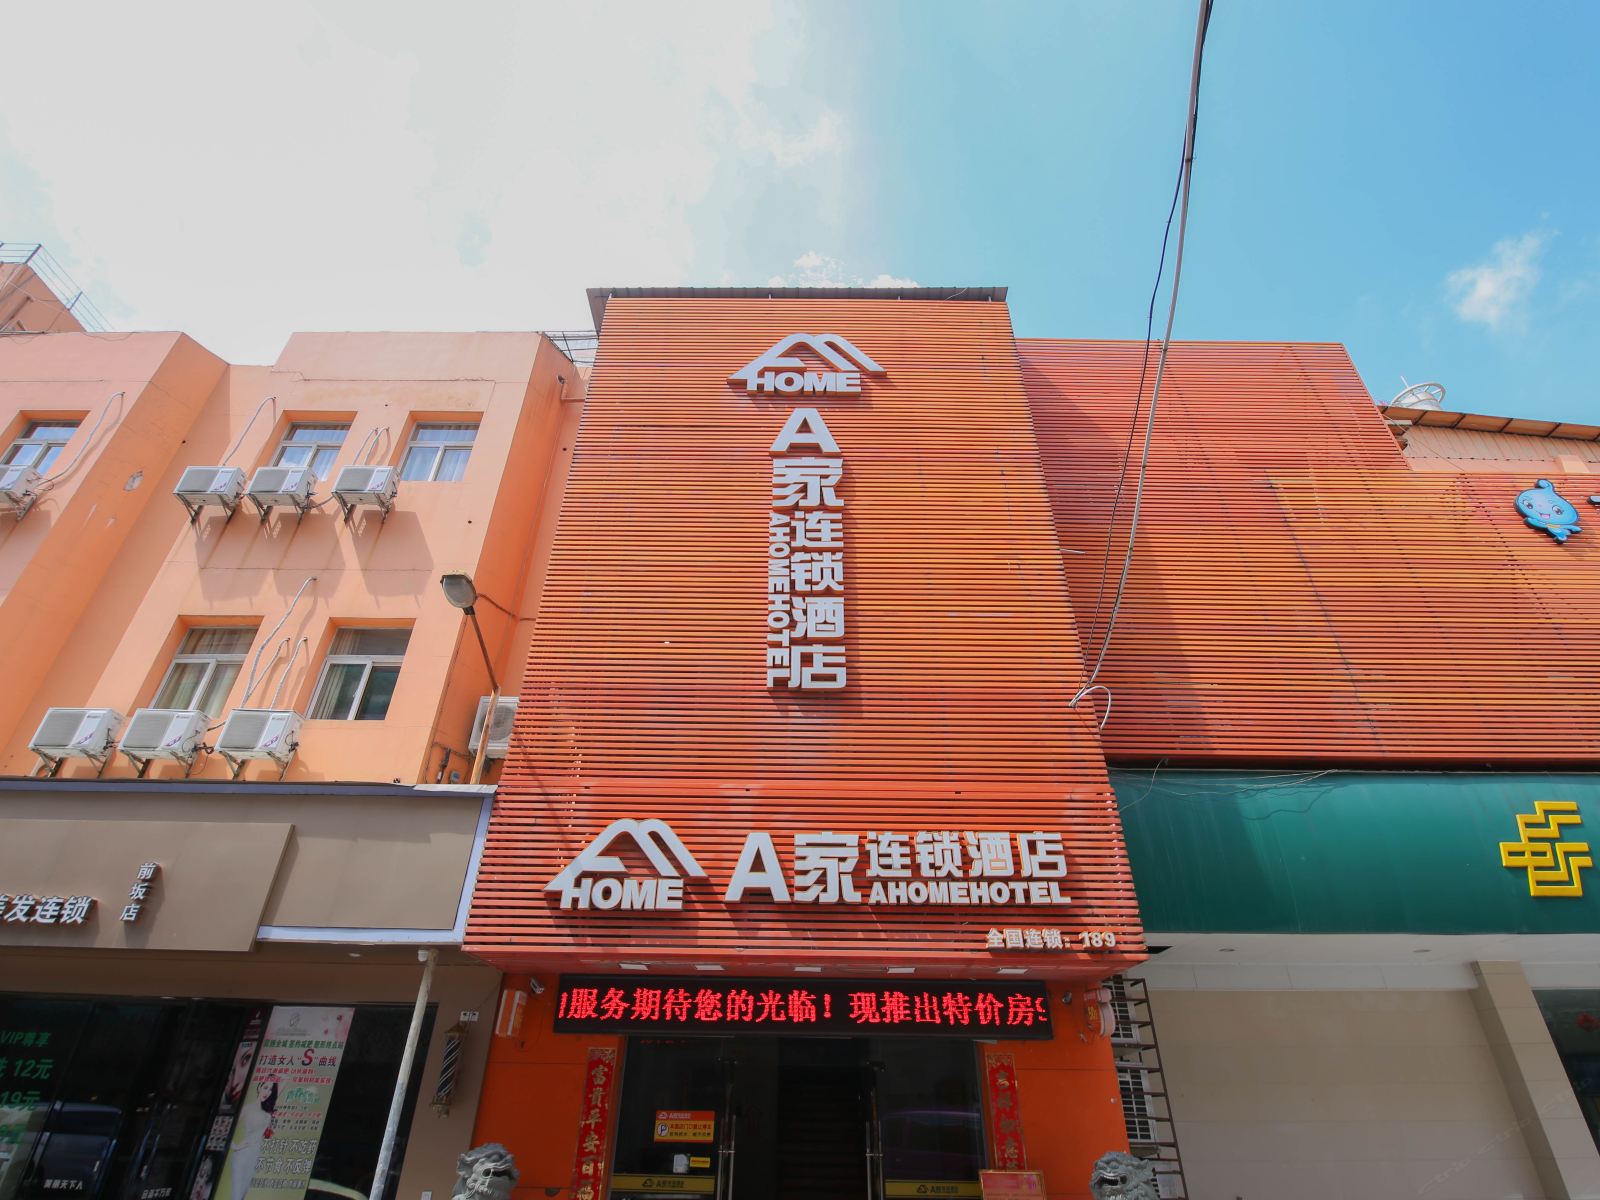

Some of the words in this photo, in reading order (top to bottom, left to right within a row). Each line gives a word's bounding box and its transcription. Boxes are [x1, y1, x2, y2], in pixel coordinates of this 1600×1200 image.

[767, 511, 791, 688] AHOMEHOTEL
[119, 862, 157, 922] 前坂店
[867, 879, 1072, 906] AHOMEHOTEL
